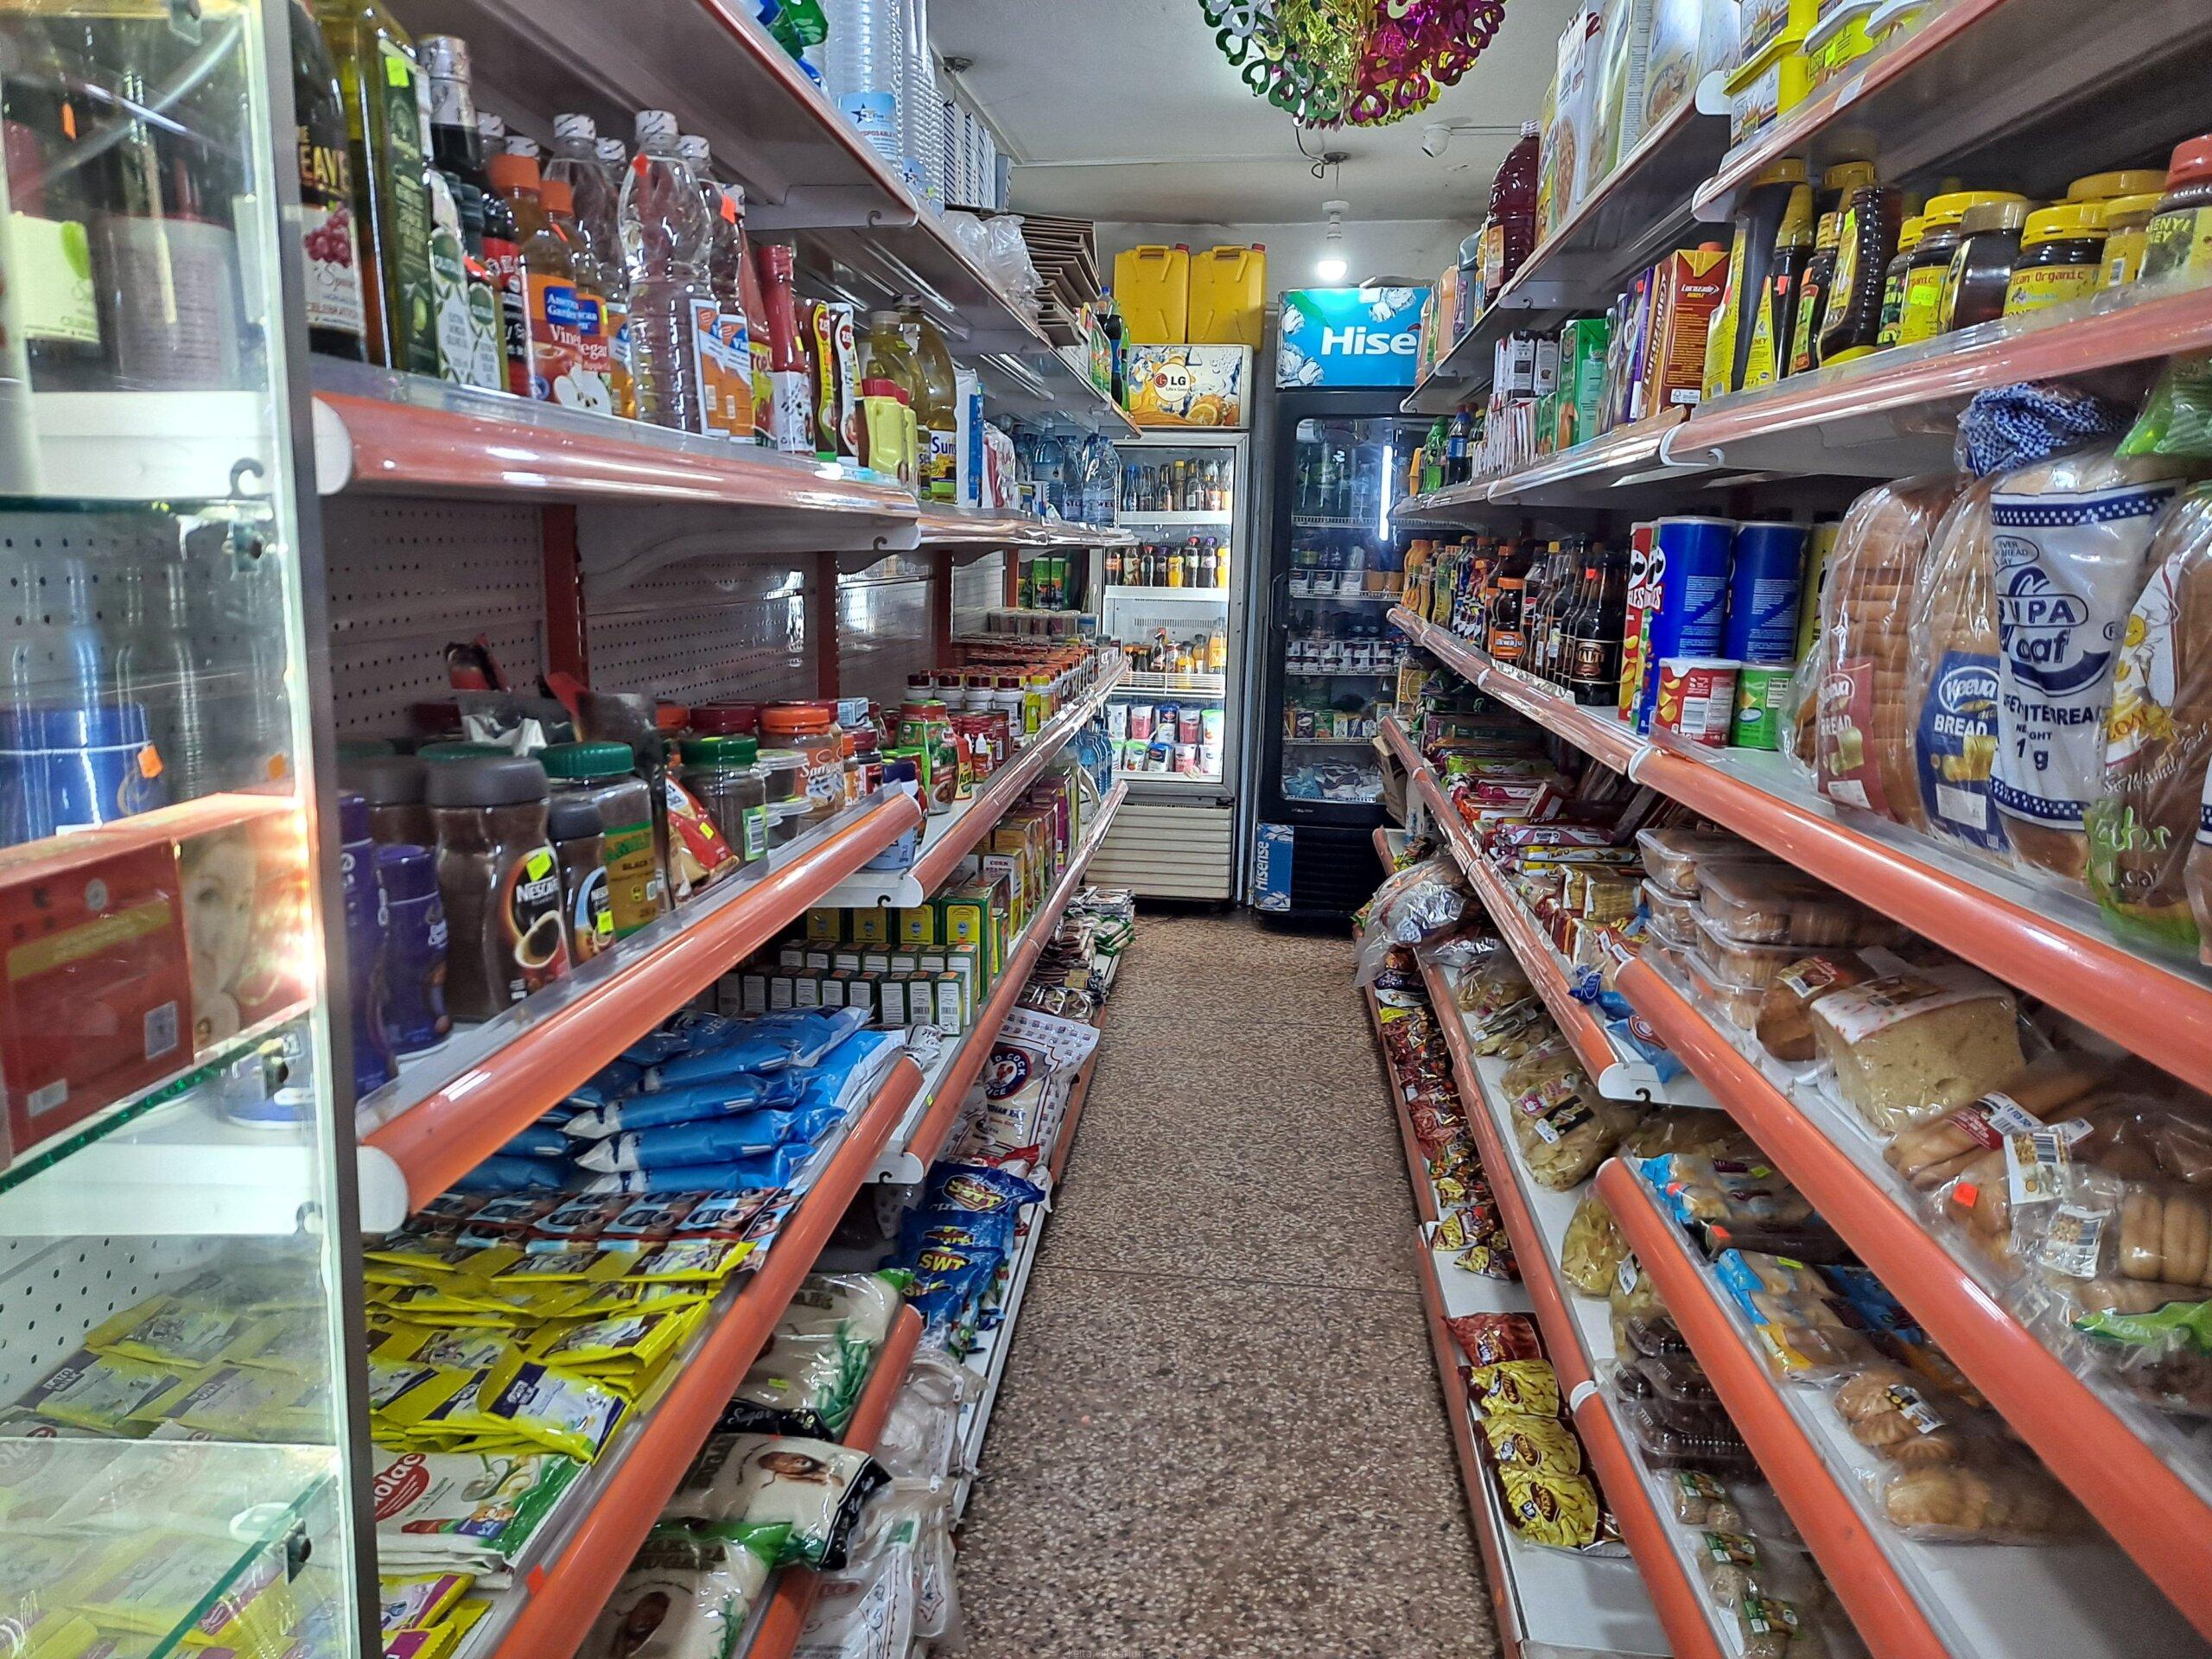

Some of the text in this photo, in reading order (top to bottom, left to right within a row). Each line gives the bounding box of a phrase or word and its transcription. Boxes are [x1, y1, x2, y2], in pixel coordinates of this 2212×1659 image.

[2034, 270, 2084, 283] Organic
[1321, 326, 1418, 356] Hise
[1171, 376, 1186, 386] LG
[1934, 713, 1988, 736] BREAD
[1255, 841, 1270, 892] Hisense
[1006, 1052, 1026, 1077] COCK
[918, 1254, 966, 1273] SWT
